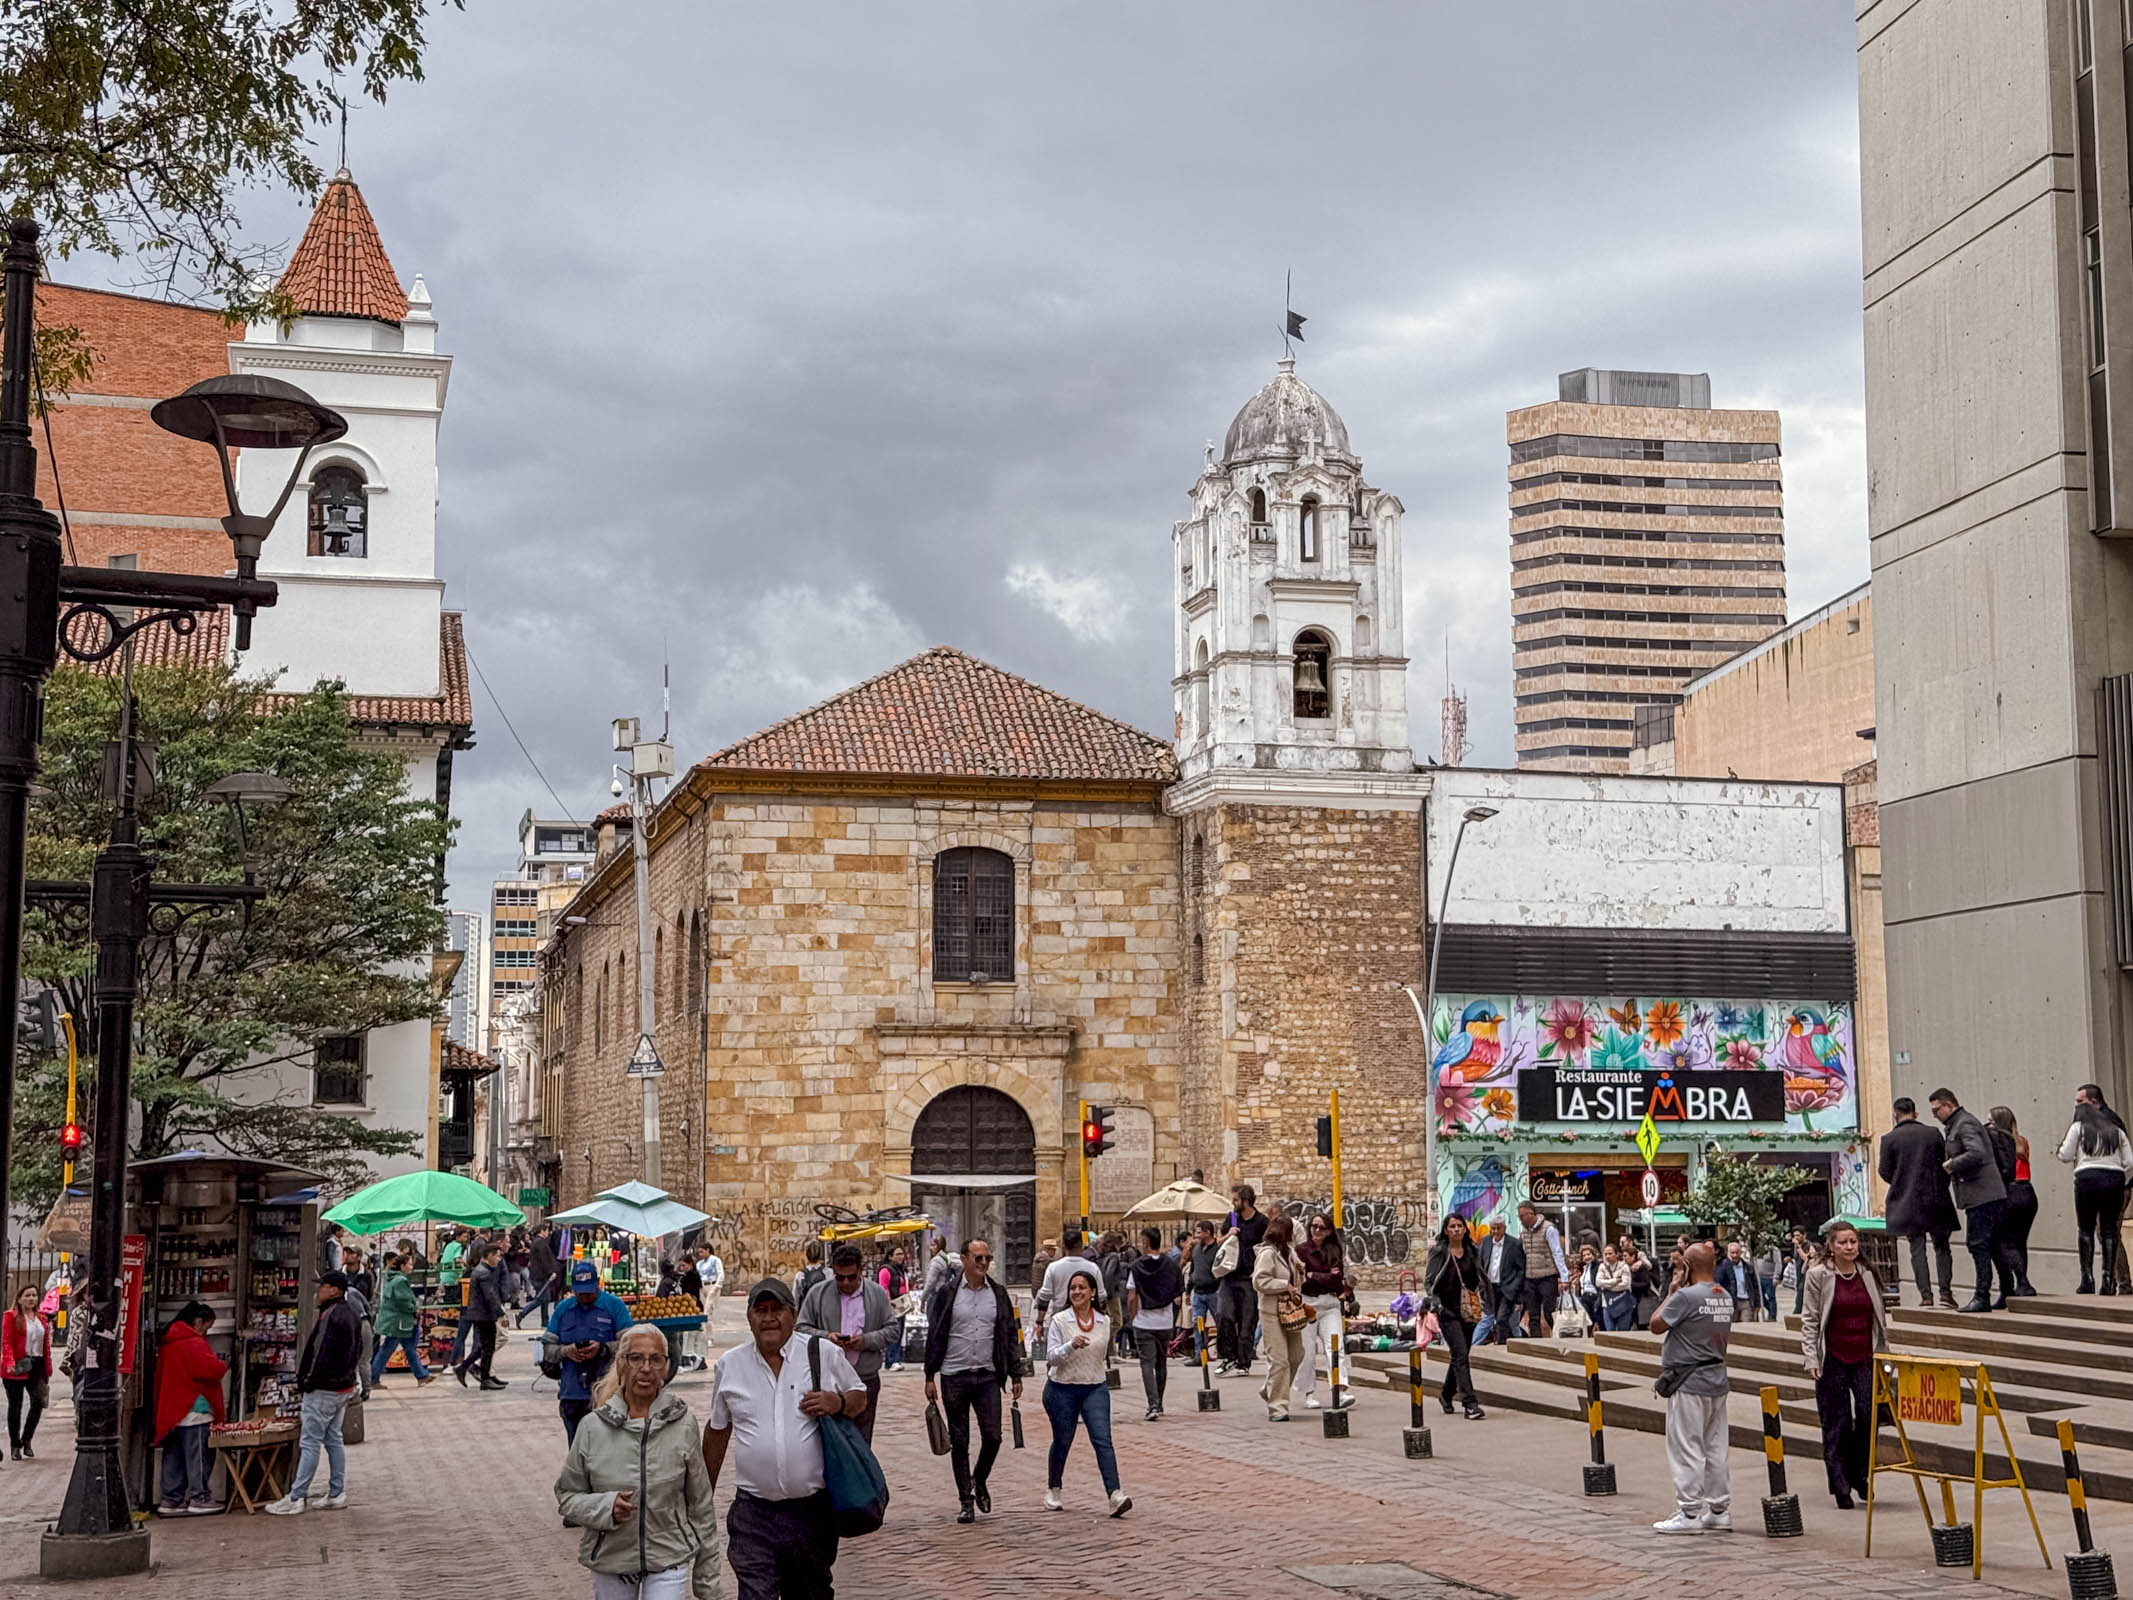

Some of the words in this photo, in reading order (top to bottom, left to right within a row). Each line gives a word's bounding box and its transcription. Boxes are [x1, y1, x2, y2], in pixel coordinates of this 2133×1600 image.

[1555, 1070, 1642, 1084] Restaurante
[1645, 1179, 1655, 1198] 10
[118, 1270, 133, 1366] MINUTOS
[1921, 1374, 1936, 1397] NO
[1900, 1396, 1957, 1423] ESTACIONE
